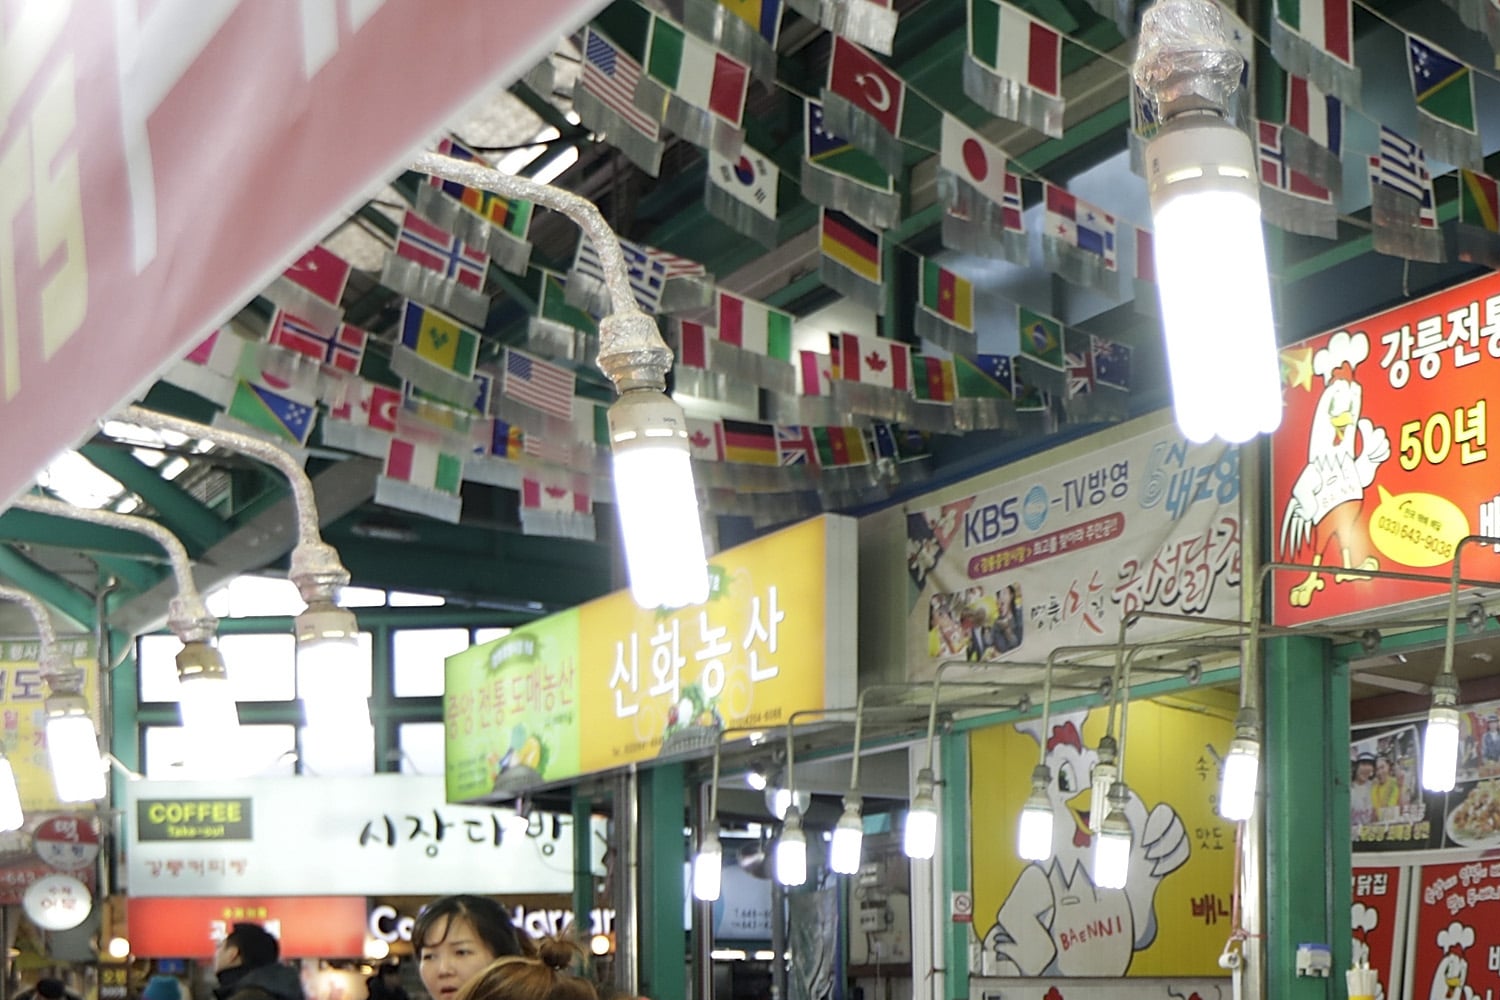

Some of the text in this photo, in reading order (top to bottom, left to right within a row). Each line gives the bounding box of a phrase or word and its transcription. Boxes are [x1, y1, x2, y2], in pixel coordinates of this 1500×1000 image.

[1399, 399, 1488, 471] 50년
[963, 497, 1020, 548] KBS
[608, 584, 786, 719] 신화농산
[479, 679, 506, 729] 전통
[511, 656, 576, 714] 도매농산
[149, 802, 242, 823] COFFEE
[1351, 873, 1389, 896] 닭집
[1060, 915, 1122, 951] BAENNI
